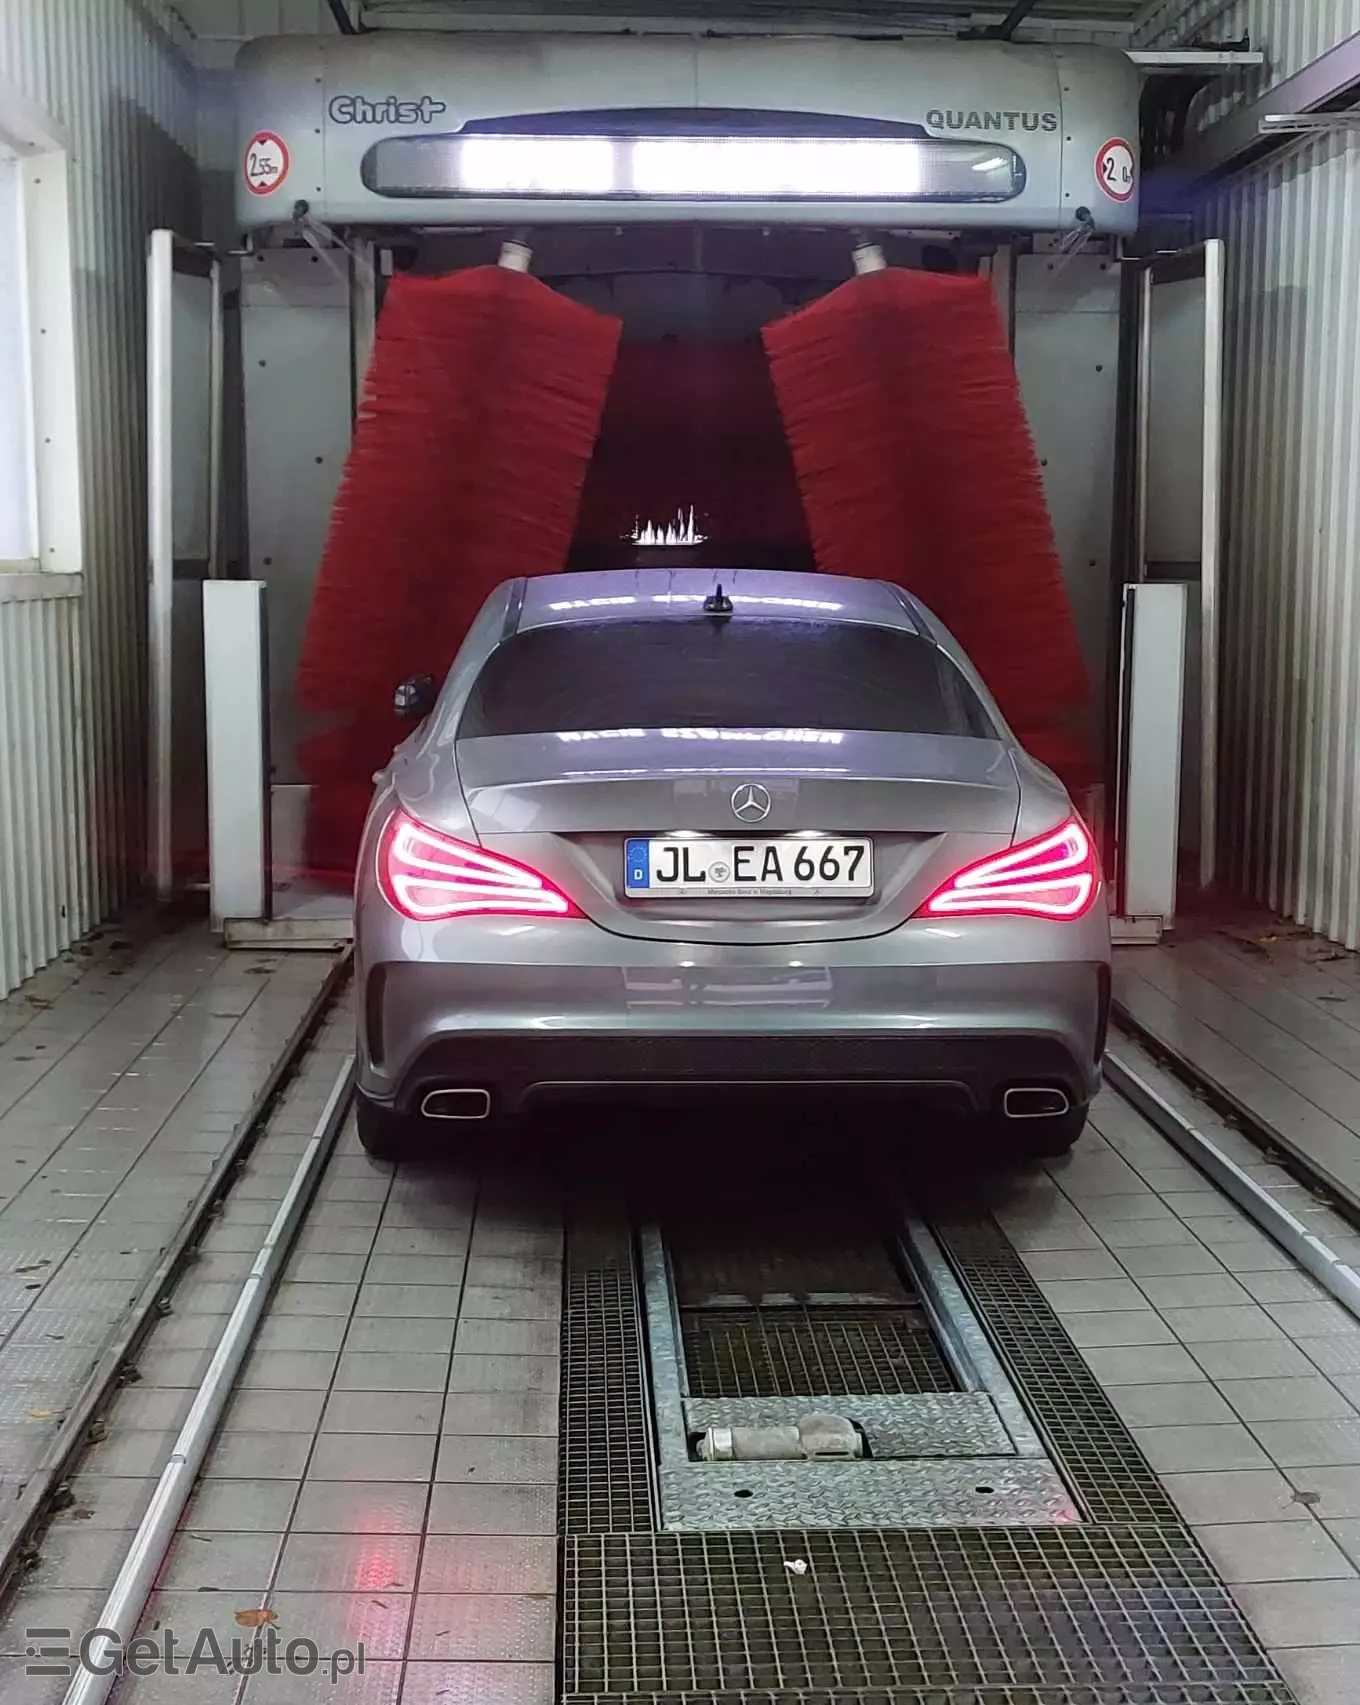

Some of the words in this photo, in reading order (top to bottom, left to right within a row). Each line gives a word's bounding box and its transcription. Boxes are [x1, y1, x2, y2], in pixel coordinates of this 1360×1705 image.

[329, 95, 446, 124] Christ
[926, 109, 1057, 132] QUANTUS
[633, 868, 644, 881] D
[656, 846, 706, 882] JL
[733, 845, 783, 882] EA
[793, 845, 865, 882] 667
